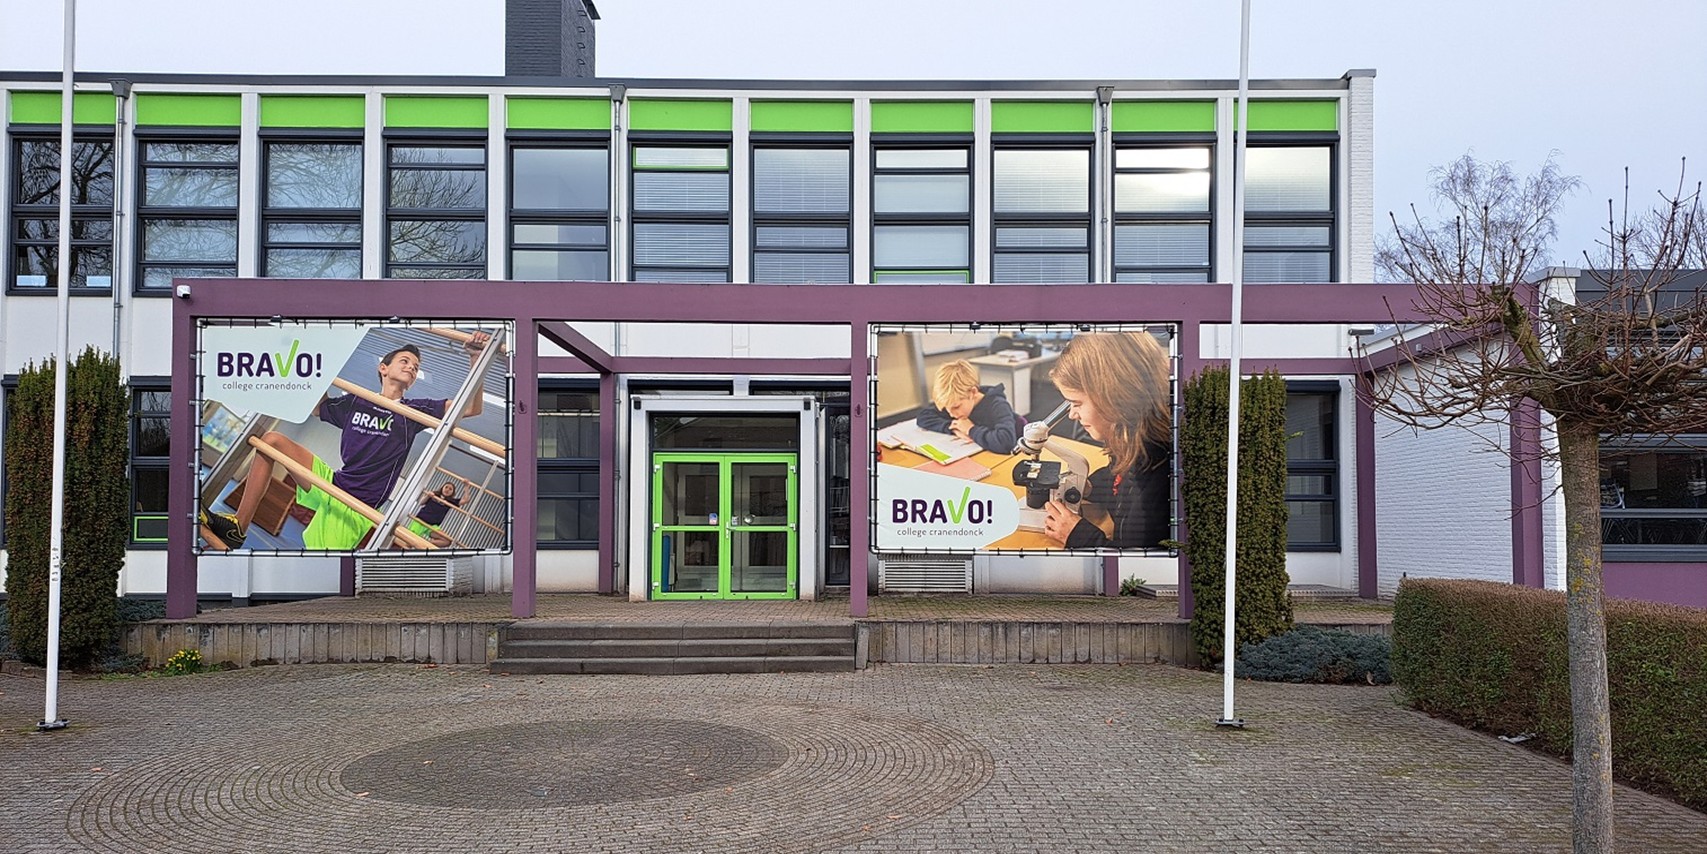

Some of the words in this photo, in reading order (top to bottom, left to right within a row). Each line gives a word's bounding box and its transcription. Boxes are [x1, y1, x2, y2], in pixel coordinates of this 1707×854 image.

[217, 339, 322, 378] BRAVO!
[222, 381, 254, 392] college
[255, 381, 312, 391] cranendonck
[892, 486, 993, 524] BRAVO!
[896, 527, 928, 538] college
[929, 527, 984, 537] cranendonck
